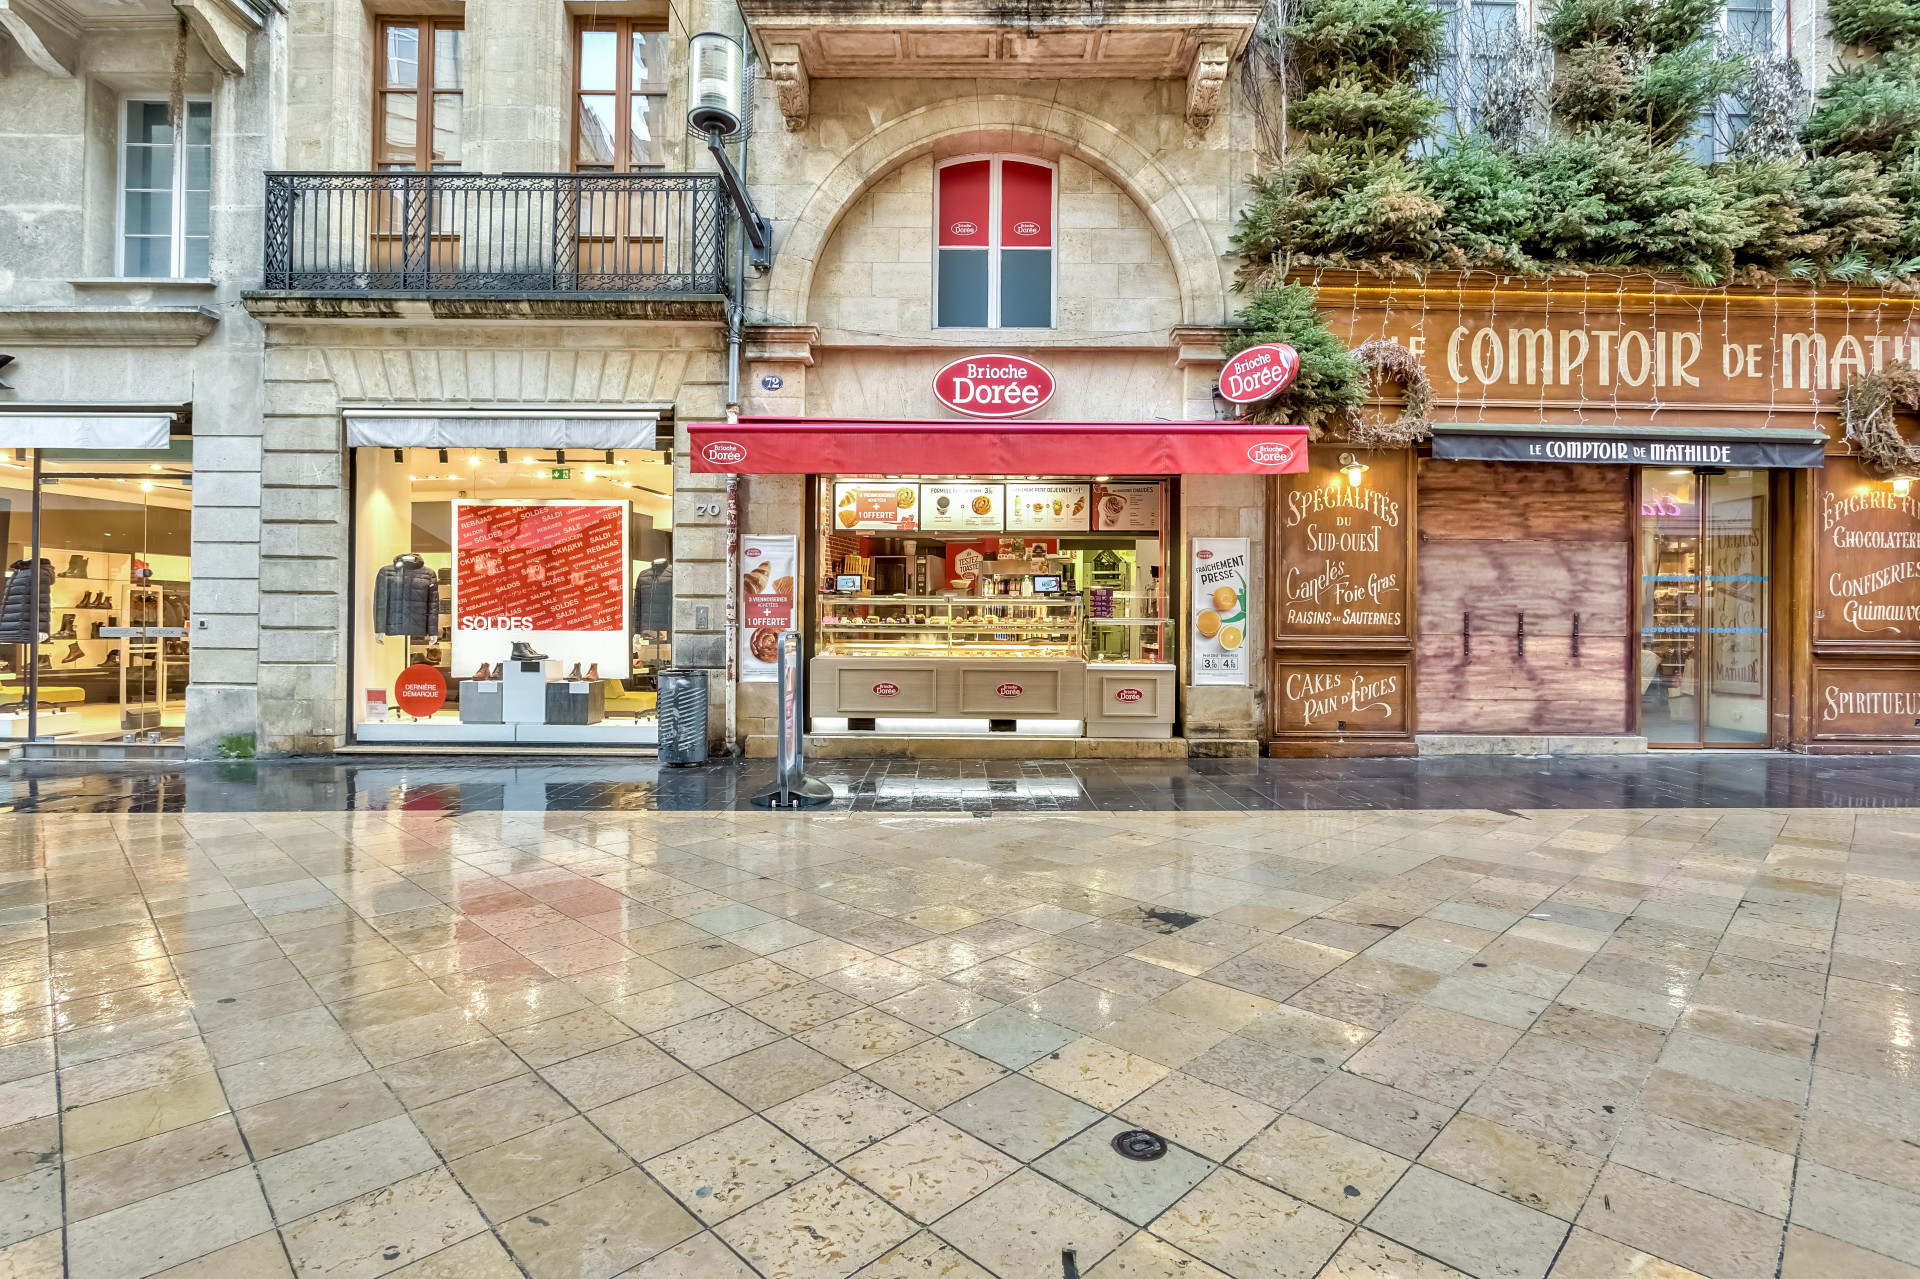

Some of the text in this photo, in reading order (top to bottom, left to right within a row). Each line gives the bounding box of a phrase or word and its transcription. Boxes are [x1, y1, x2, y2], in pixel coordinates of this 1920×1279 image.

[1234, 353, 1271, 374] Brioche
[1447, 327, 1700, 387] COMPTOIR
[1722, 343, 1763, 378] DE
[966, 364, 1027, 378] Brioche
[765, 378, 780, 388] 72
[1228, 366, 1282, 397] Dorée
[952, 378, 1038, 404] Dorée
[709, 450, 741, 460] Dorée
[1255, 451, 1287, 461] Dorée
[1530, 441, 1731, 463] LE COMPTOIR DE MATHILDE
[696, 504, 720, 516] 70
[1287, 485, 1399, 528] SPÉCIALITÉS
[1822, 490, 1896, 532] ÉPICERIE
[461, 515, 492, 529] REBAJAS
[463, 528, 484, 538] SALDOS
[520, 507, 549, 520] SOLDES
[542, 511, 563, 522] SALDI
[1336, 516, 1352, 526] DU
[474, 530, 502, 544] SOLDES
[498, 544, 517, 554] SALE
[563, 523, 582, 533] SALE
[589, 532, 611, 543] SALDI
[1307, 524, 1382, 552] SUD-OUEST
[552, 541, 583, 556] СКИДКИ
[521, 564, 542, 576] SALDI
[586, 539, 619, 554] REBAJAS
[959, 556, 978, 566] TESTEZ
[487, 566, 506, 576] SALE
[1201, 569, 1234, 585] PRESSE
[496, 580, 520, 592] SALDOS
[542, 576, 565, 587] SOLDES
[1286, 560, 1345, 604] Canelés
[1334, 572, 1396, 605] Foie Gras
[530, 590, 551, 600] SALDOS
[542, 597, 557, 606] SALE
[584, 584, 599, 592] SALE
[550, 598, 579, 612] SOLDES
[556, 608, 577, 620] SALDI
[593, 615, 612, 626] SALE
[1287, 609, 1332, 624] RAISINS
[1342, 609, 1400, 626] SAUTERNES
[462, 616, 533, 630] SOLDES
[1716, 658, 1758, 683] MATHILDE
[1286, 674, 1341, 701] CAKES
[1303, 698, 1338, 727] PAIN
